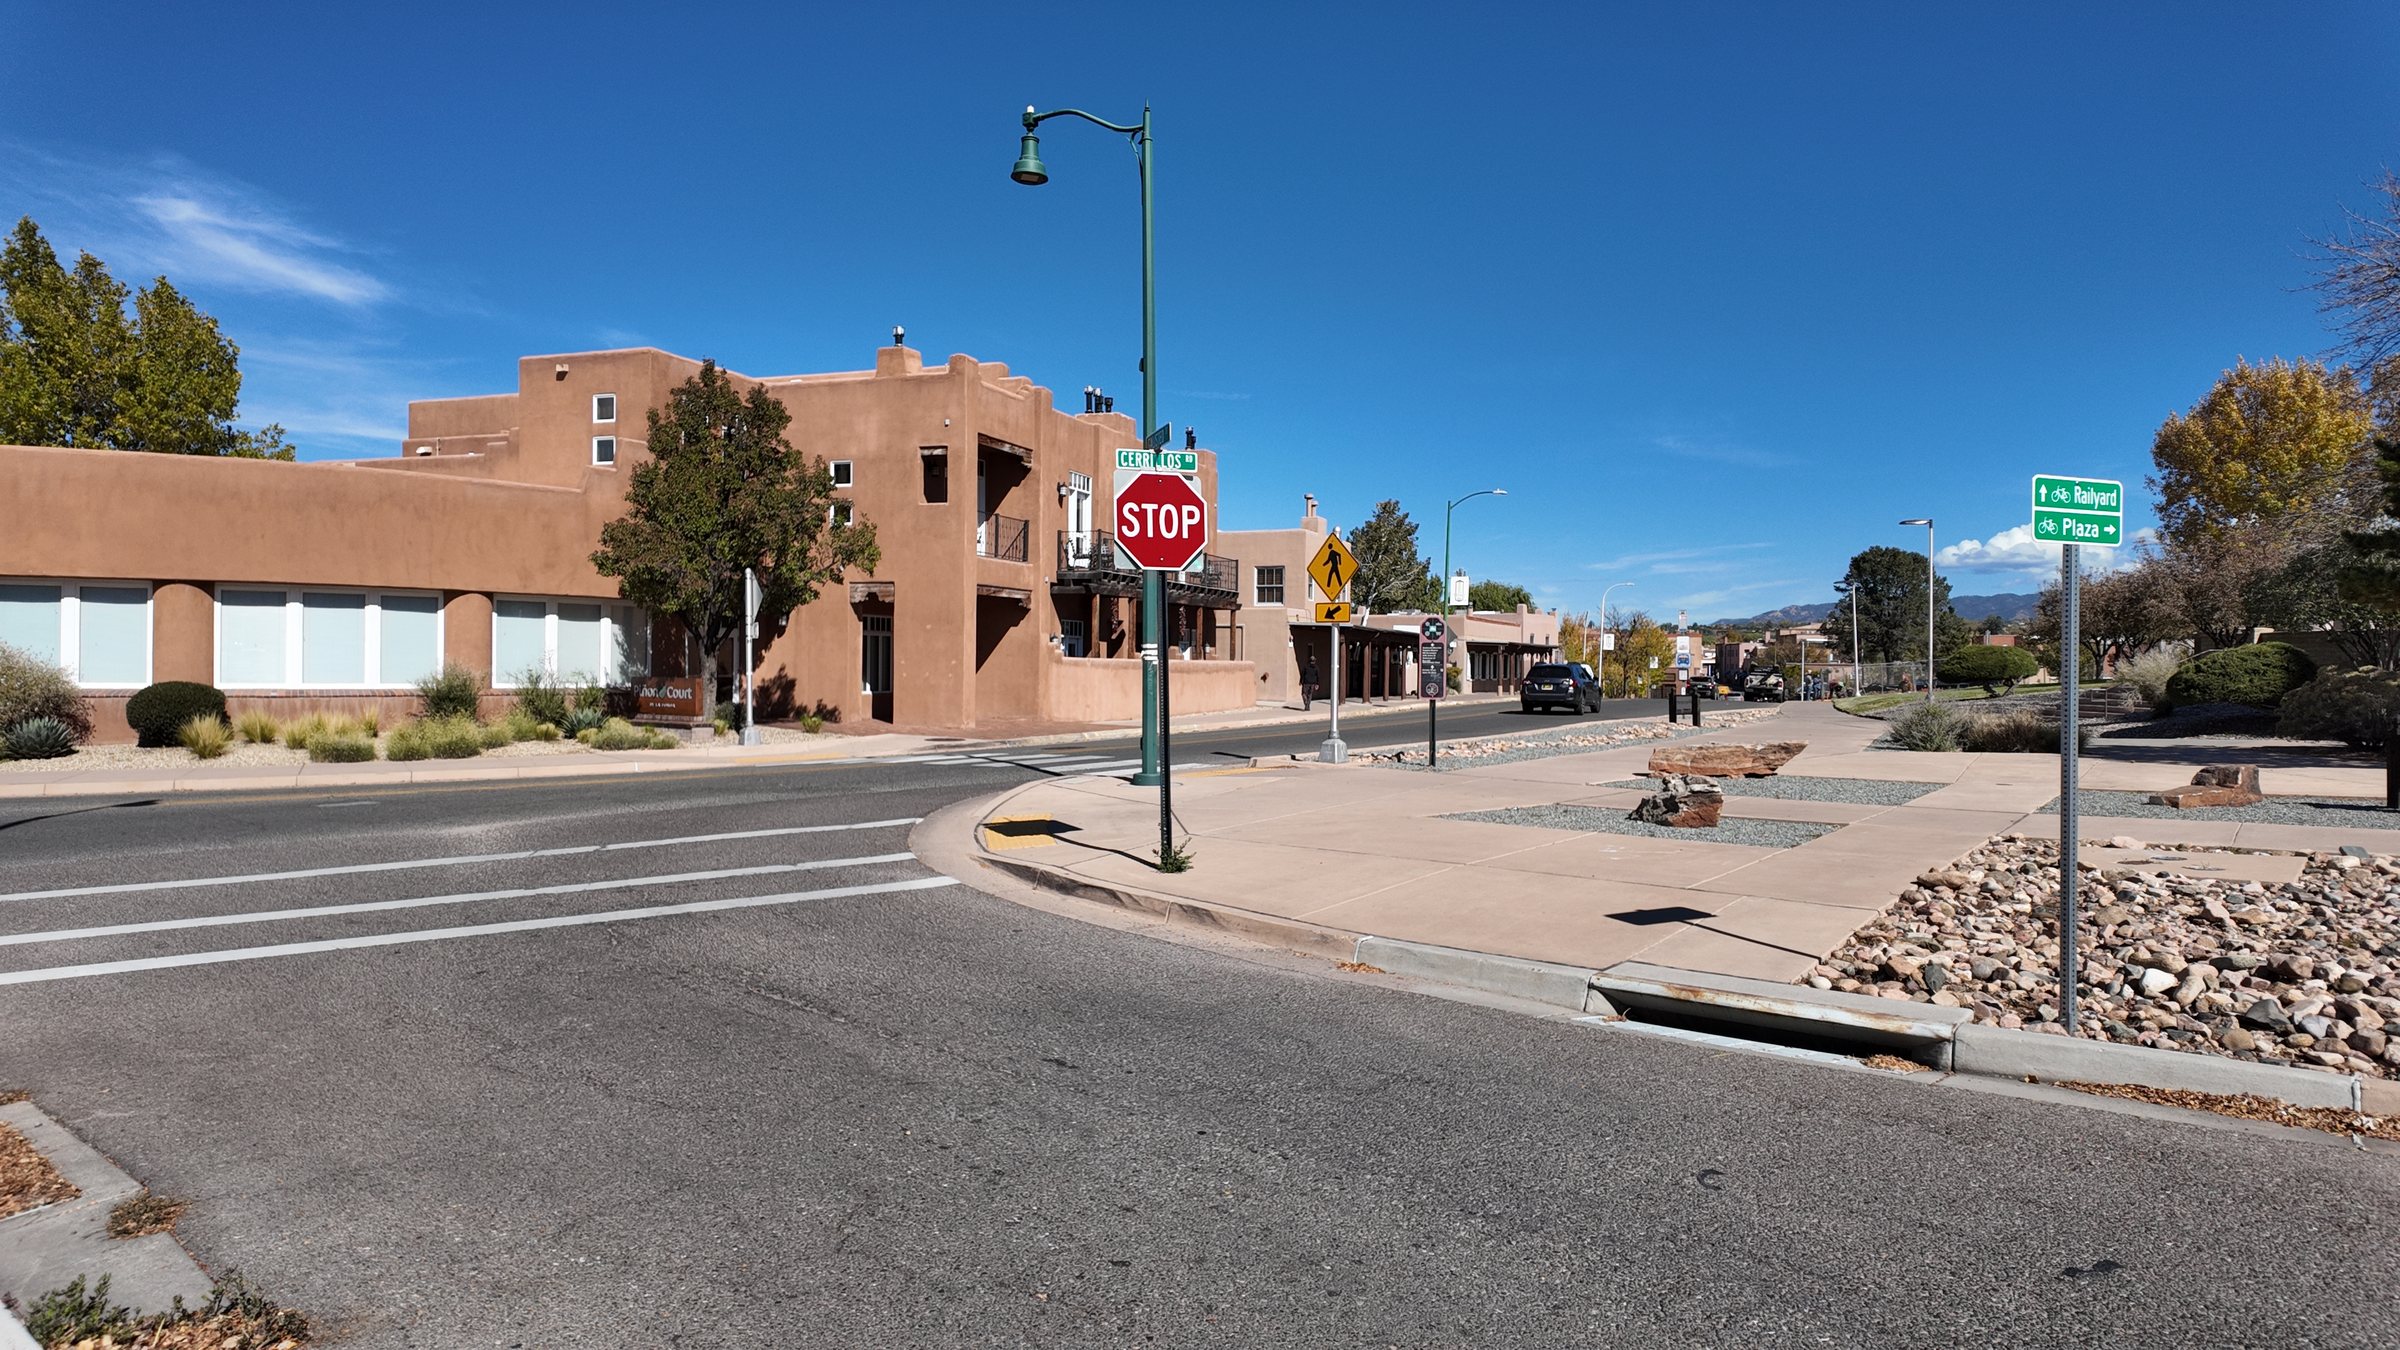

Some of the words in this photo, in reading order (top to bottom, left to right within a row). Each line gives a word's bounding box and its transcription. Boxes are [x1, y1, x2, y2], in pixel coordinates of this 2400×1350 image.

[1185, 454, 1193, 464] RD
[2074, 486, 2117, 509] Railyard
[1121, 502, 1201, 539] STOP
[2062, 518, 2099, 538] Plaza
[667, 686, 693, 700] Court
